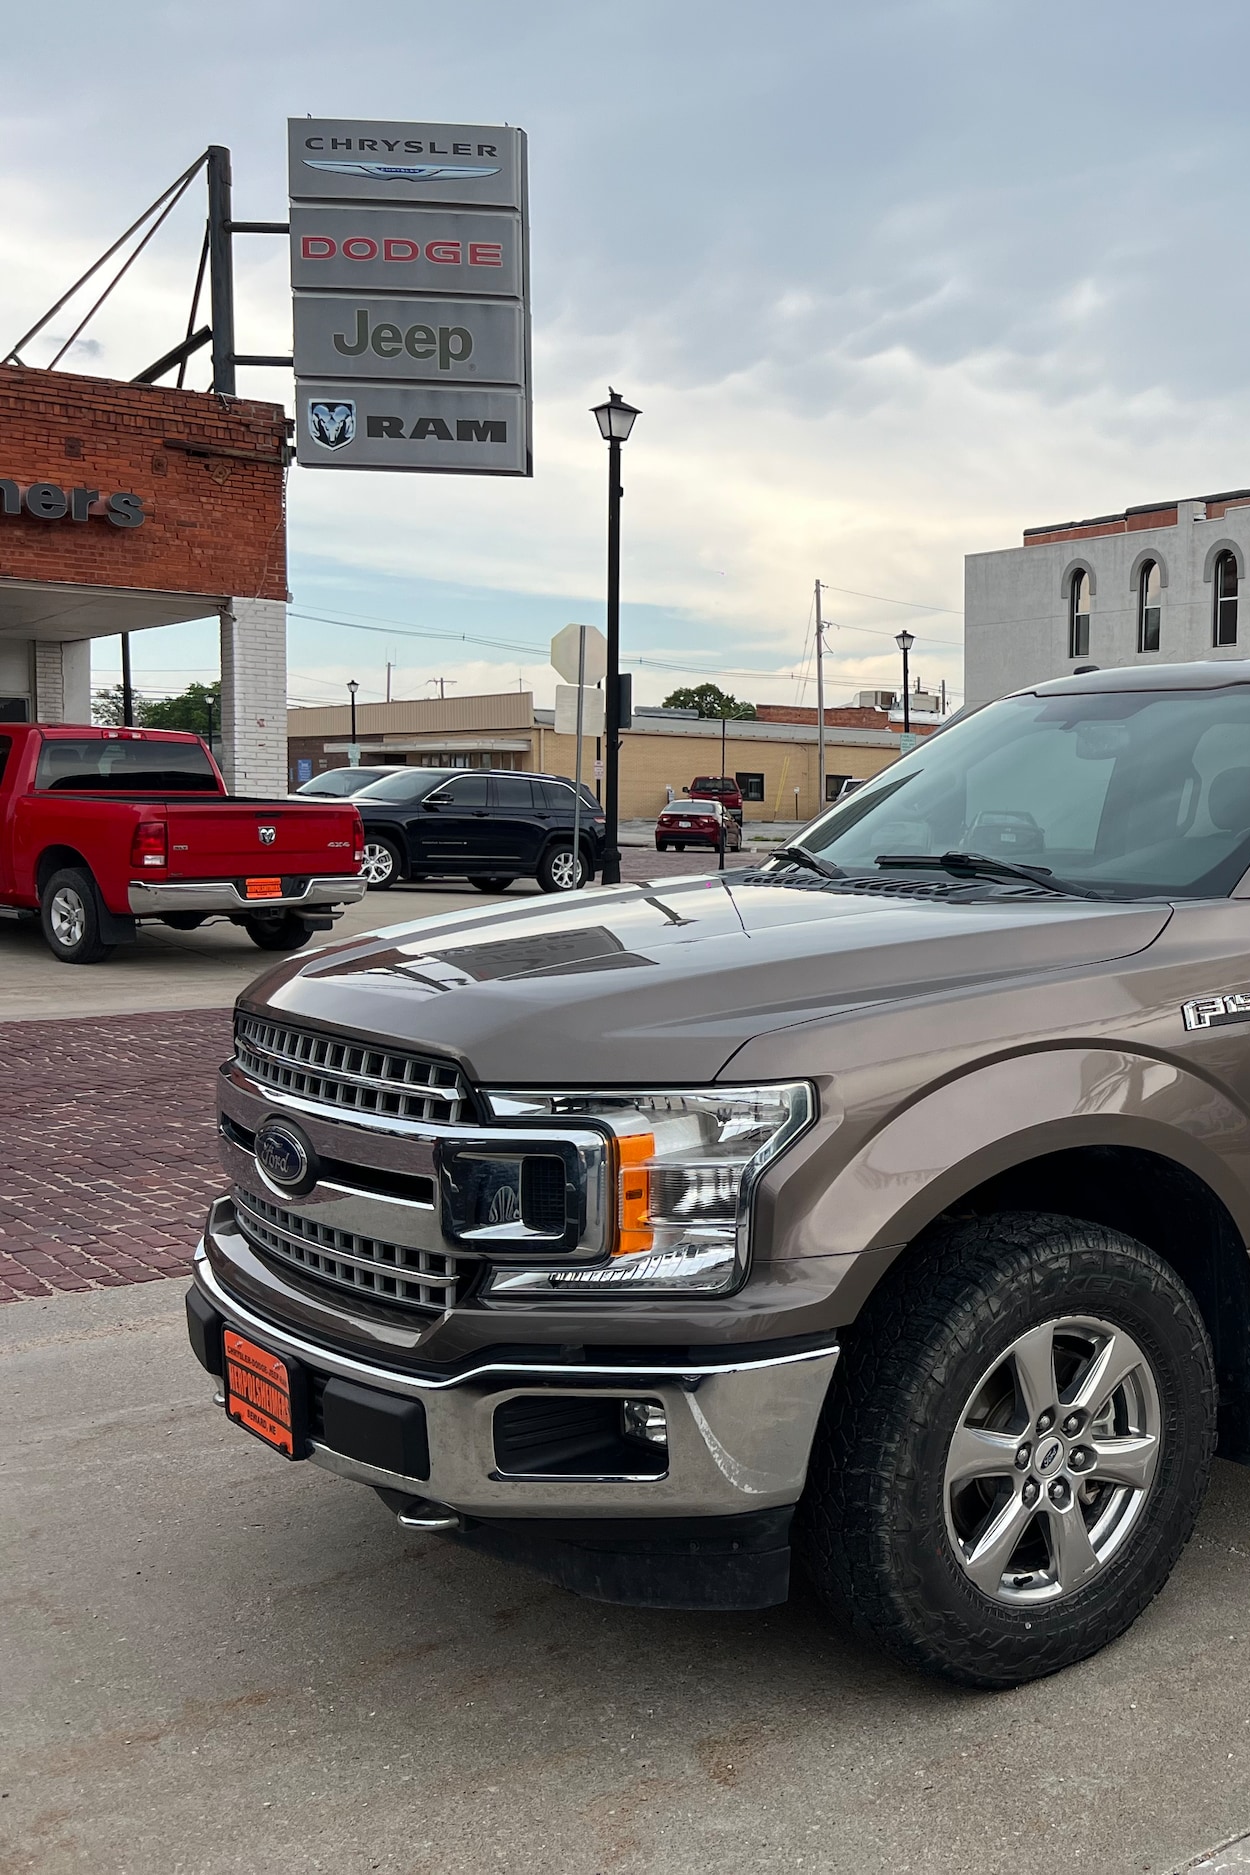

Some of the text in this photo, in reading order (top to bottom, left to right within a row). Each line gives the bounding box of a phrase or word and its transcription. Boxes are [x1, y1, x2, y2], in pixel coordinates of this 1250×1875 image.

[304, 137, 499, 157] CHRYSLER
[301, 236, 503, 267] DODGE
[333, 309, 473, 370] Jeep
[366, 415, 507, 443] RAM
[261, 1137, 290, 1173] Ford
